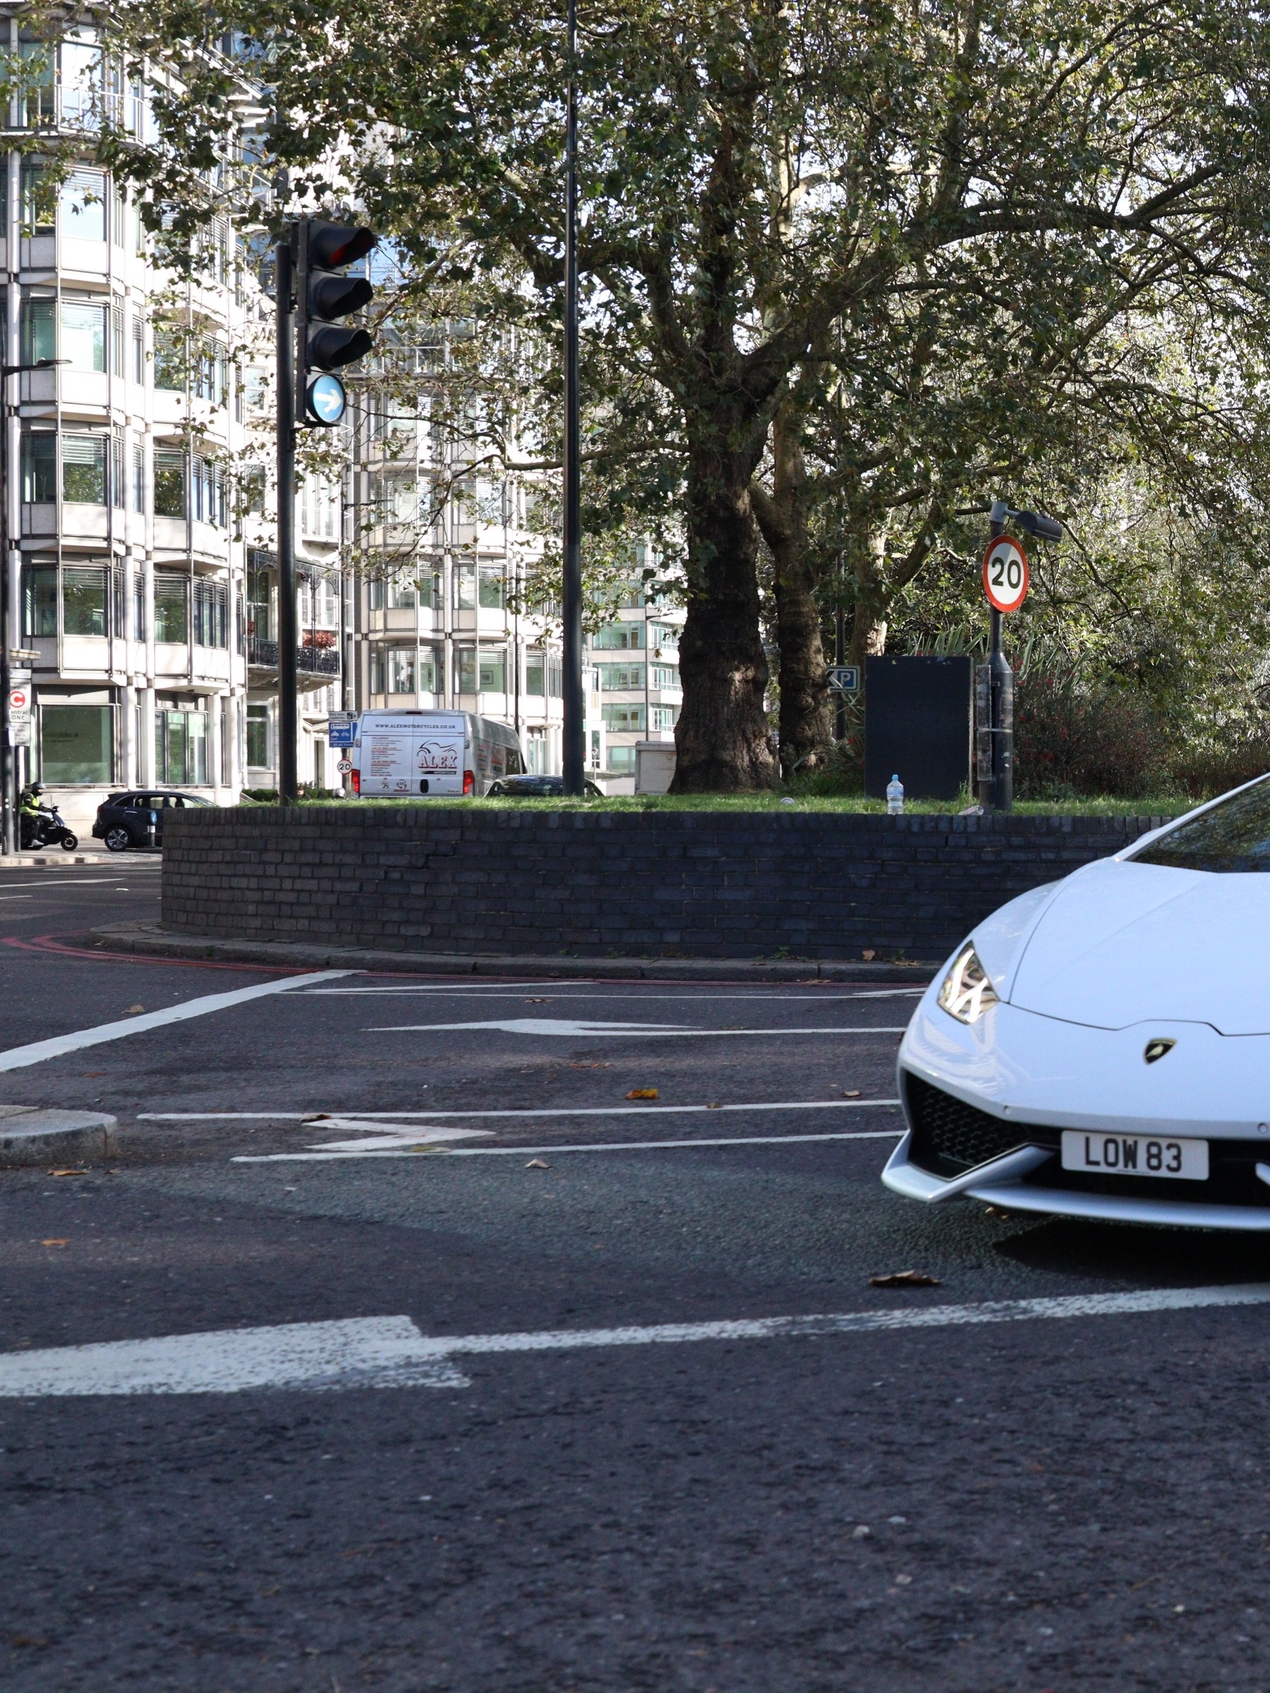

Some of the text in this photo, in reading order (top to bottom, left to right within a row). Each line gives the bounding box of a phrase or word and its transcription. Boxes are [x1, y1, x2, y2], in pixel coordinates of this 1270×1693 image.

[991, 557, 1021, 589] 20
[840, 672, 851, 686] P
[339, 763, 351, 771] 20
[418, 755, 458, 769] ALEX
[1084, 1136, 1182, 1173] LOW 83
